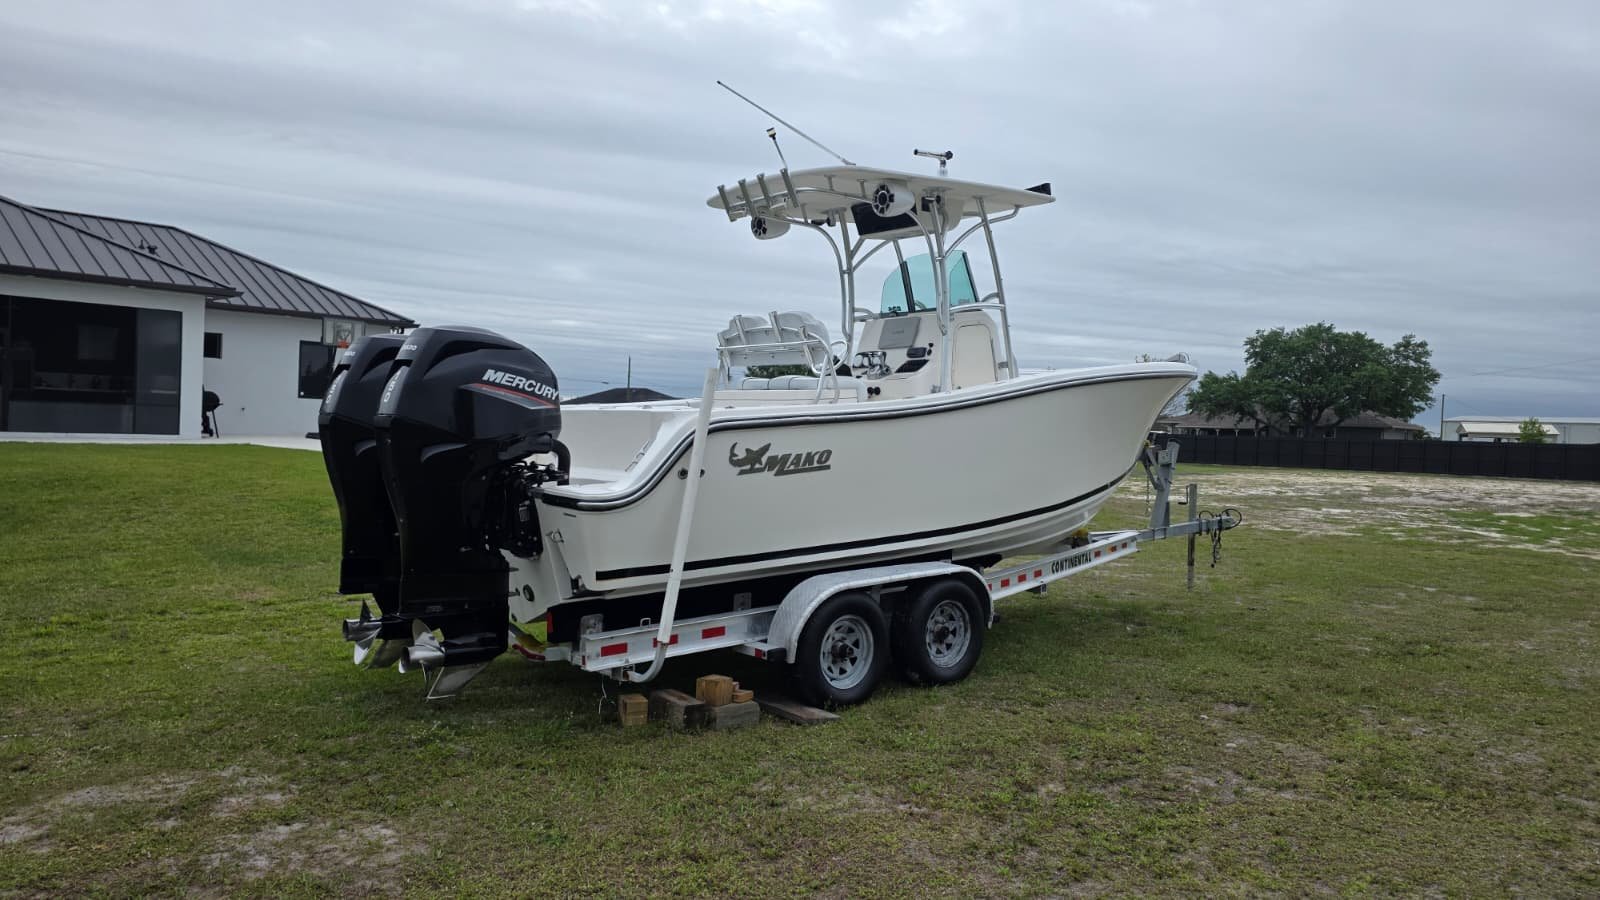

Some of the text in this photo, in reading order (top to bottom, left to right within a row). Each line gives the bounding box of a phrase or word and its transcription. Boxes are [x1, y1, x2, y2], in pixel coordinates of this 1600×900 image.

[482, 369, 559, 400] MERCURY
[763, 449, 832, 476] MAKO
[1051, 552, 1092, 574] CONTINENTAL
